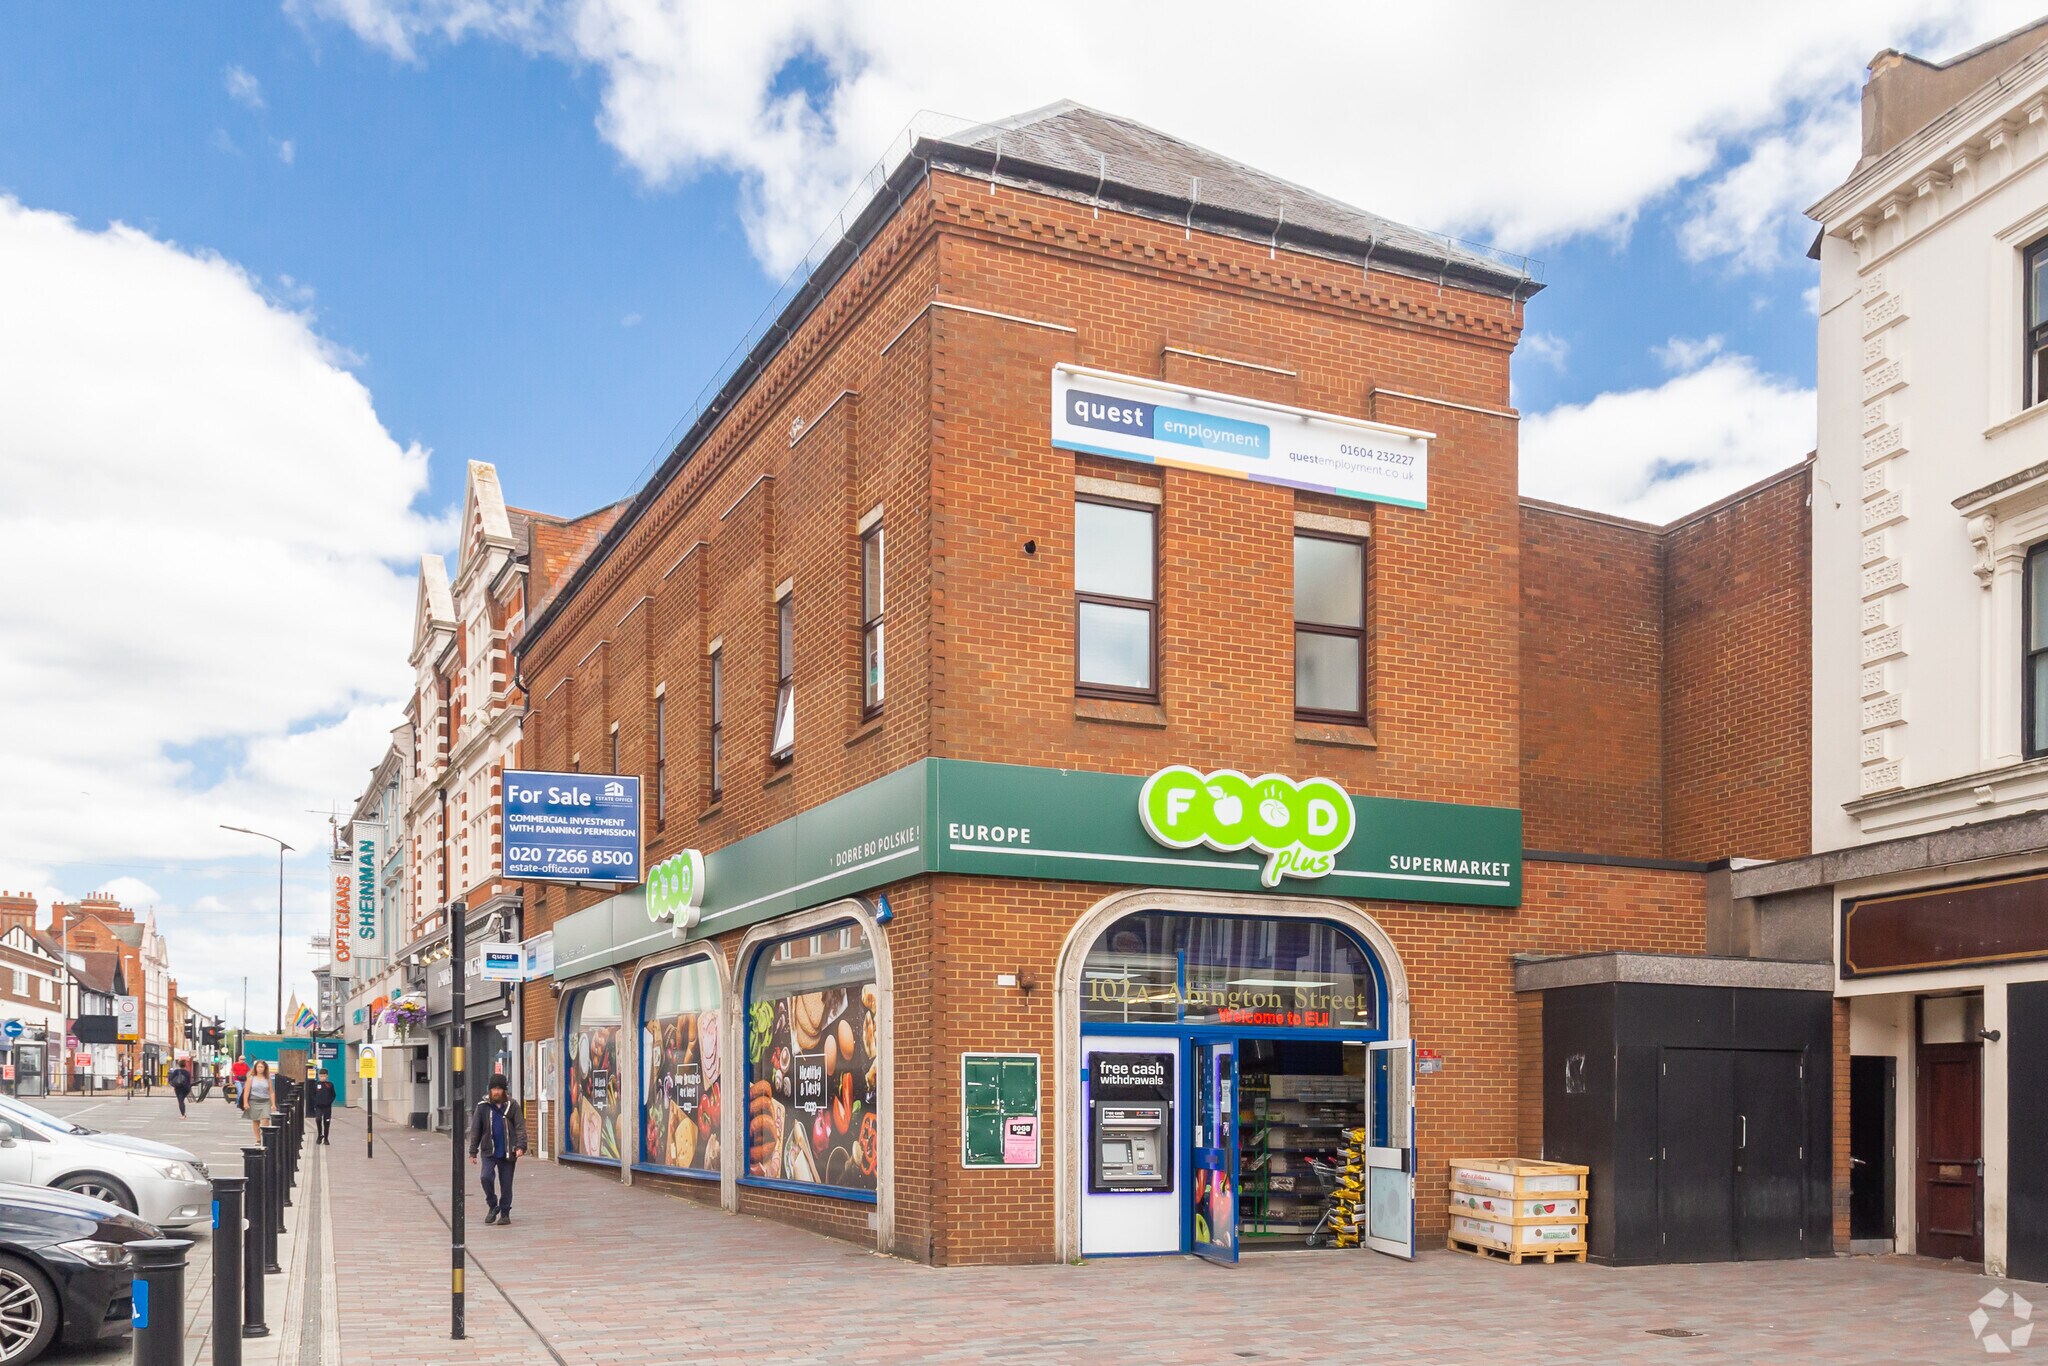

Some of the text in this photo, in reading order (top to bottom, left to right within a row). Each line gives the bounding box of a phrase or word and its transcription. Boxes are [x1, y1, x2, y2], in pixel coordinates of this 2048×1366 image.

[1074, 399, 1260, 448] quest employment
[1340, 444, 1415, 466] 01604 232227
[508, 785, 591, 806] For Sale
[509, 814, 626, 827] COMMERCIAL INVESTMENT
[509, 825, 636, 838] WITH PLANNING PERMISSION
[949, 823, 1031, 844] EUROPE
[509, 847, 633, 865] 020 7266 8500
[836, 845, 863, 867] DOBRE
[864, 840, 876, 857] BO
[878, 827, 914, 853] POLSKIE
[509, 863, 590, 875] estate-office.com
[1272, 847, 1330, 881] plus
[1389, 855, 1511, 877] SUPERMARKET
[358, 840, 375, 939] SHEINMAN
[335, 875, 351, 963] OPTICIANS
[1089, 978, 1367, 1011] 102A Abington Street
[1217, 1008, 1284, 1023] Welcome
[1287, 1011, 1302, 1024] to
[799, 1065, 822, 1081] Healthy
[1100, 1061, 1164, 1075] free cash
[800, 1080, 821, 1097] & Tasty
[1100, 1074, 1164, 1085] withdrawals
